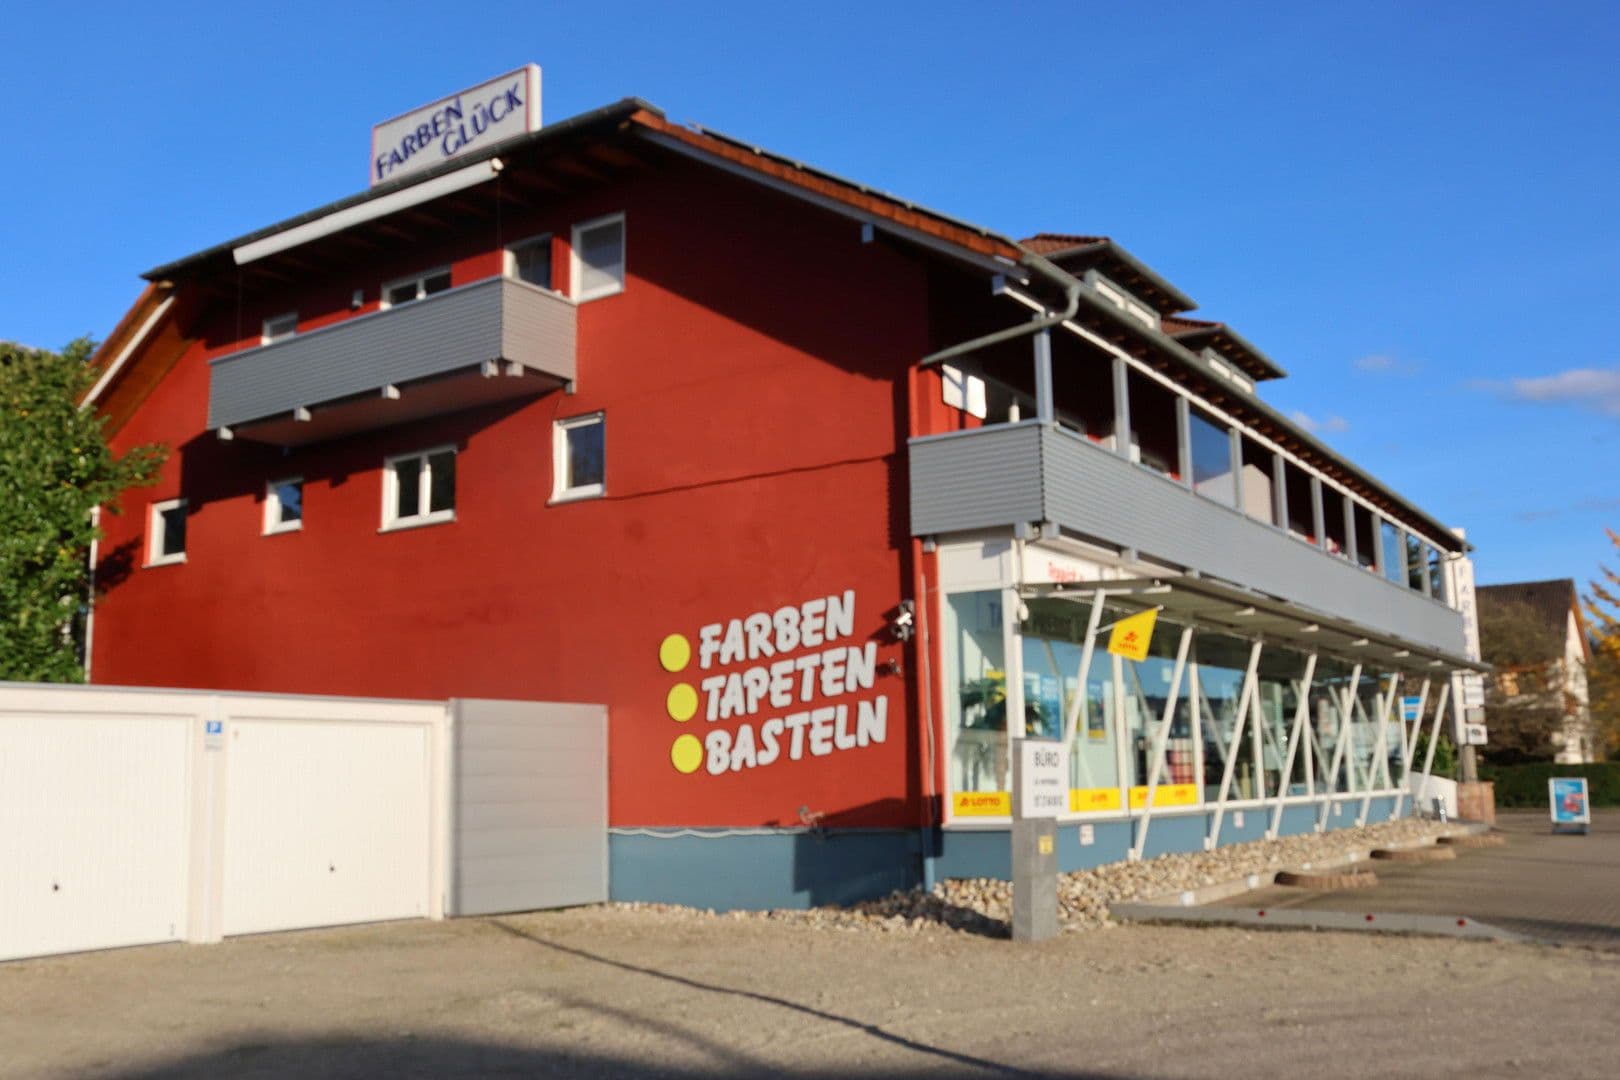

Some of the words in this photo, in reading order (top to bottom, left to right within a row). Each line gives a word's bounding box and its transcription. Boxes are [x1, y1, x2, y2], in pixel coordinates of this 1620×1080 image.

[376, 96, 463, 179] FARBEN
[442, 83, 523, 156] GLÜCK
[699, 590, 855, 669] FARBEN
[701, 641, 877, 722] TAPETEN
[705, 695, 888, 775] BASTELN
[1034, 747, 1060, 768] BÜRO
